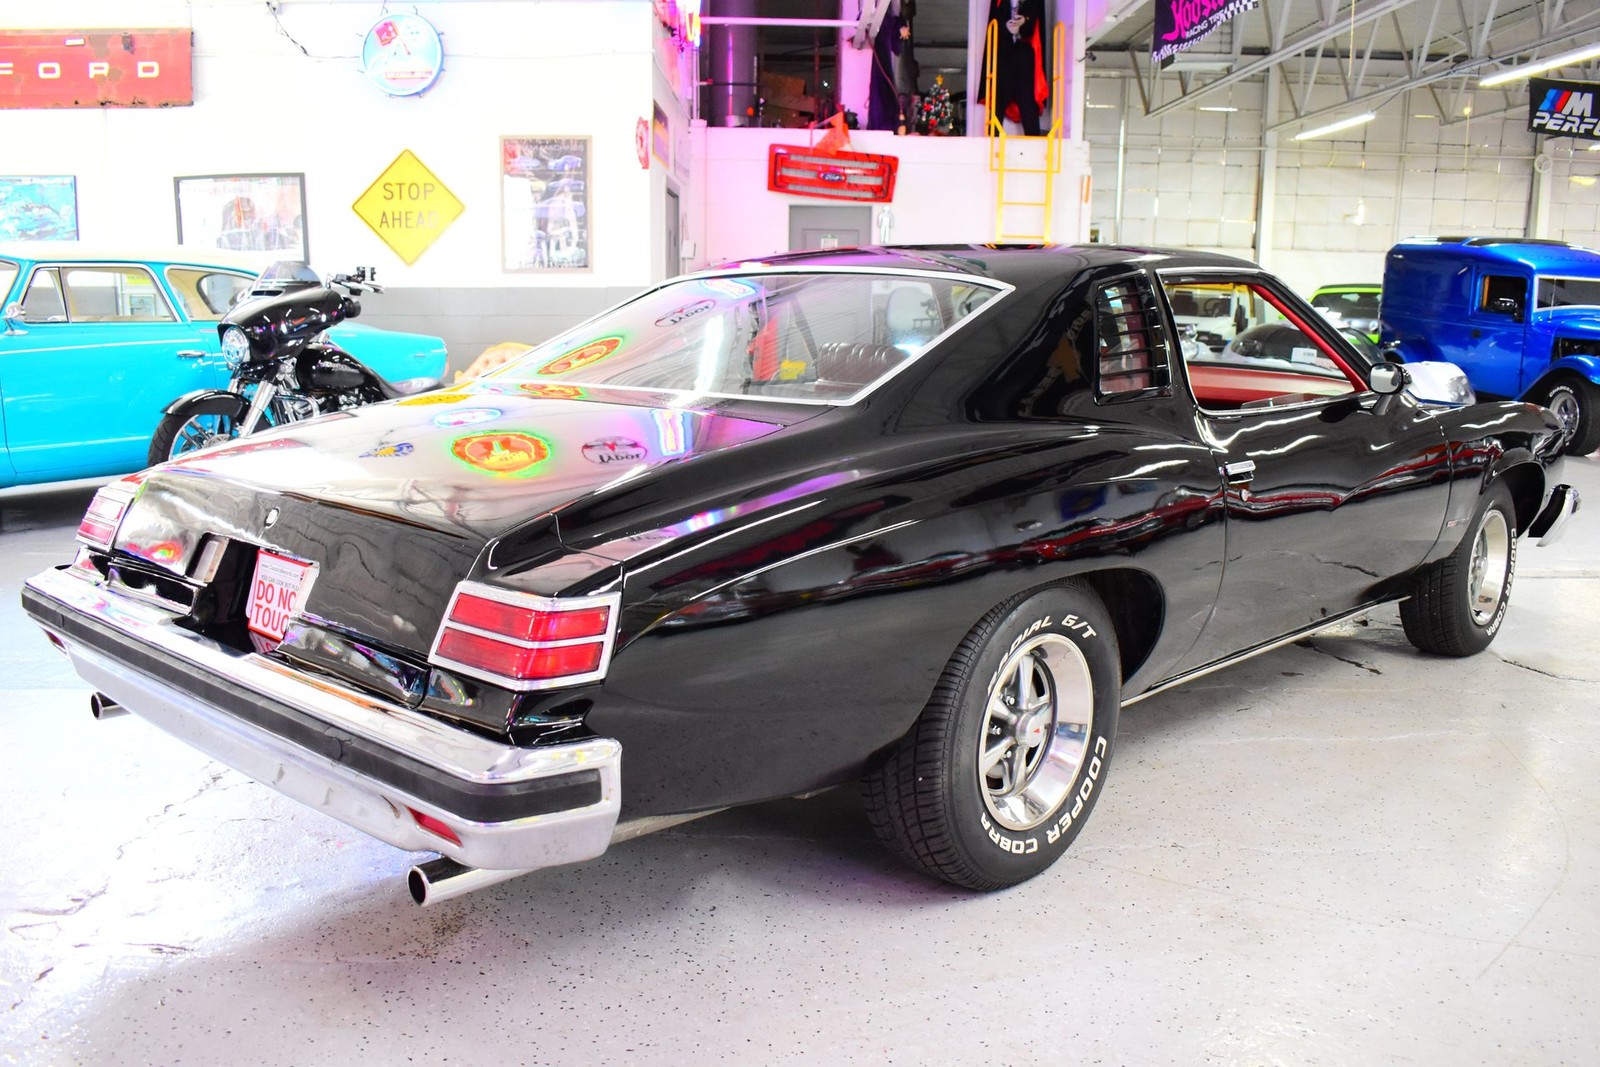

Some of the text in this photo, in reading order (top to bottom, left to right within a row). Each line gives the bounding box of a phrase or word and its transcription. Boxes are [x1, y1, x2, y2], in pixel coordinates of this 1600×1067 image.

[1185, 20, 1209, 39] RACING
[0, 61, 160, 79] FORD
[1561, 91, 1594, 117] M
[383, 183, 435, 201] STOP
[380, 211, 438, 229] AHEAD
[256, 580, 296, 612] DO NO
[255, 603, 289, 634] TOUC
[1061, 614, 1097, 639] G/T
[1485, 601, 1506, 636] COBRA
[981, 735, 1107, 854] COOPER COBRA
